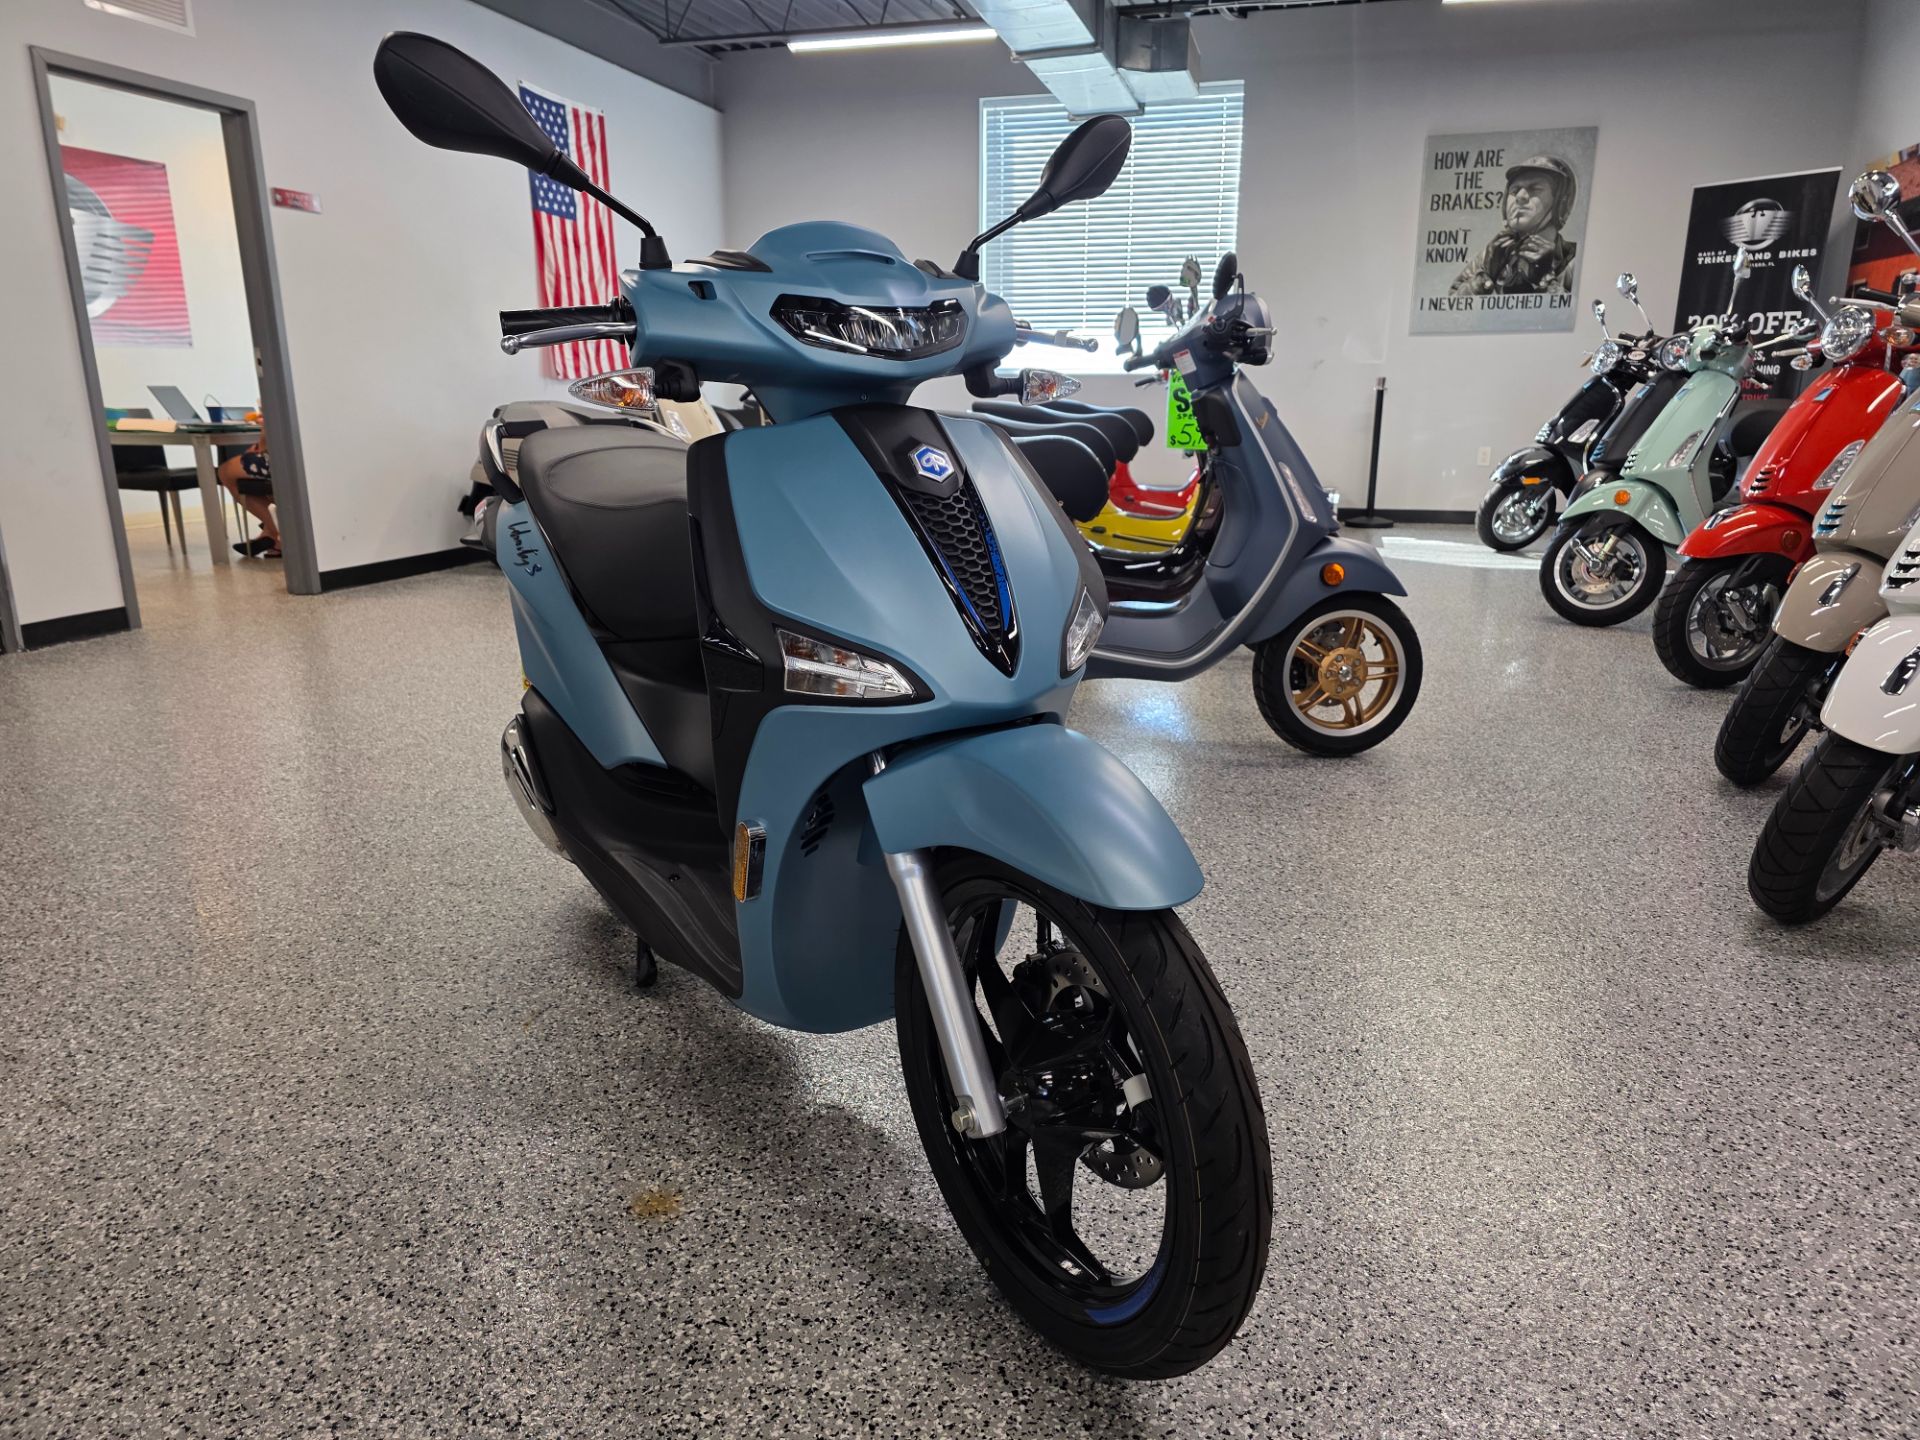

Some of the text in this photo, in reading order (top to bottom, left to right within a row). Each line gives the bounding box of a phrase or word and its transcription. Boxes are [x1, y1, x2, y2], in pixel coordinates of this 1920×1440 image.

[1434, 149, 1505, 170] HOW ARE
[1454, 171, 1485, 190] THE
[1430, 191, 1504, 212] BRAKES?
[1427, 227, 1472, 246] DON'T
[1747, 252, 1772, 261] AND
[1778, 248, 1818, 259] BIKES
[1420, 294, 1572, 311] I NEVER TOUCHED EM
[1748, 311, 1802, 336] OFF
